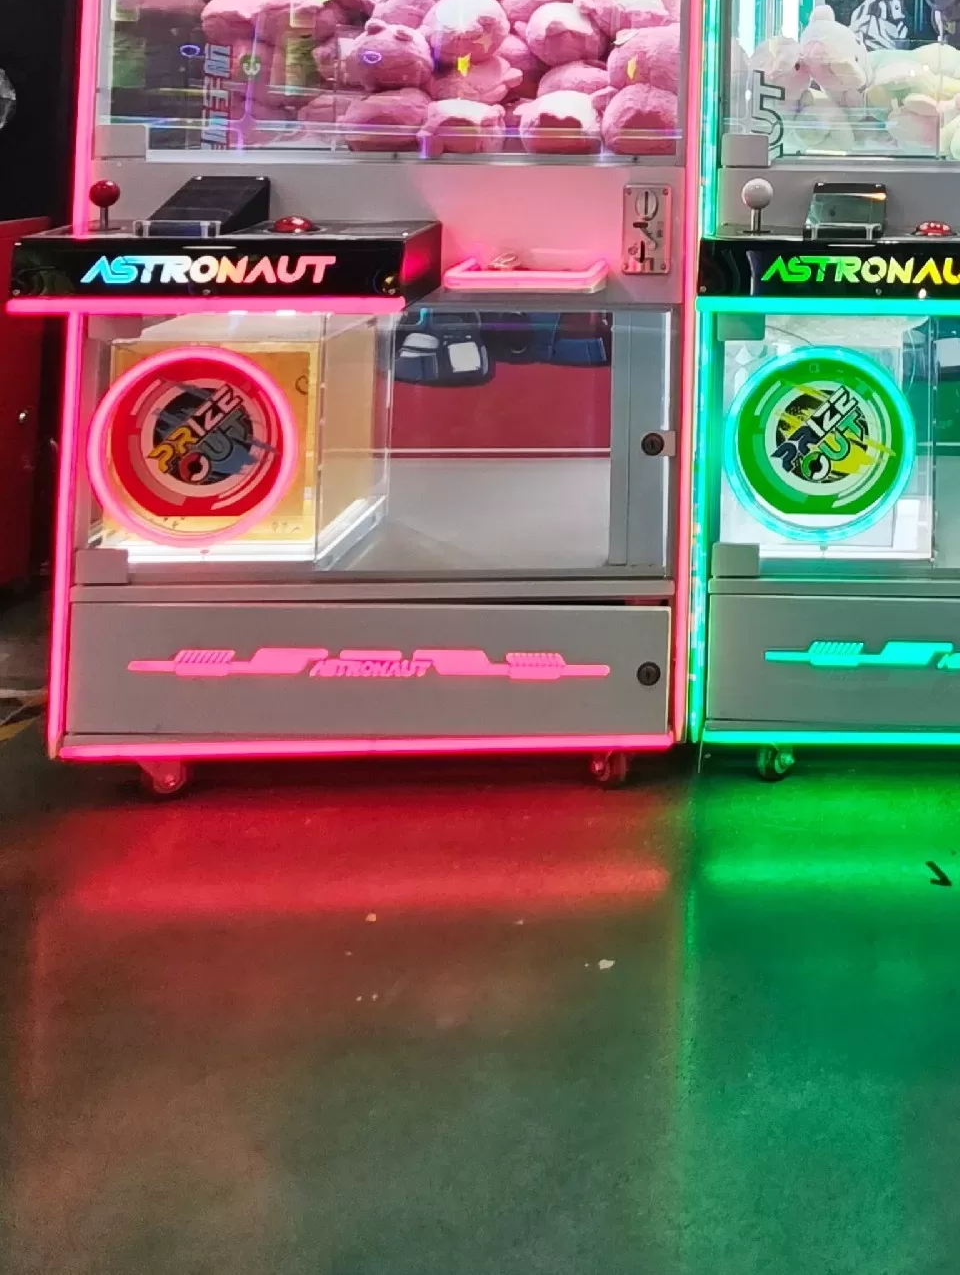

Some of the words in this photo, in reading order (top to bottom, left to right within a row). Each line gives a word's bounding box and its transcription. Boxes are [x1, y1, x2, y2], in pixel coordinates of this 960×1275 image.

[80, 255, 337, 284] ASTRONAUT
[146, 383, 243, 475] PRIZE
[178, 406, 250, 485] OUT
[770, 385, 858, 473] PRIZE
[801, 407, 864, 484] OUT
[309, 659, 432, 677] ASTRONAUT
